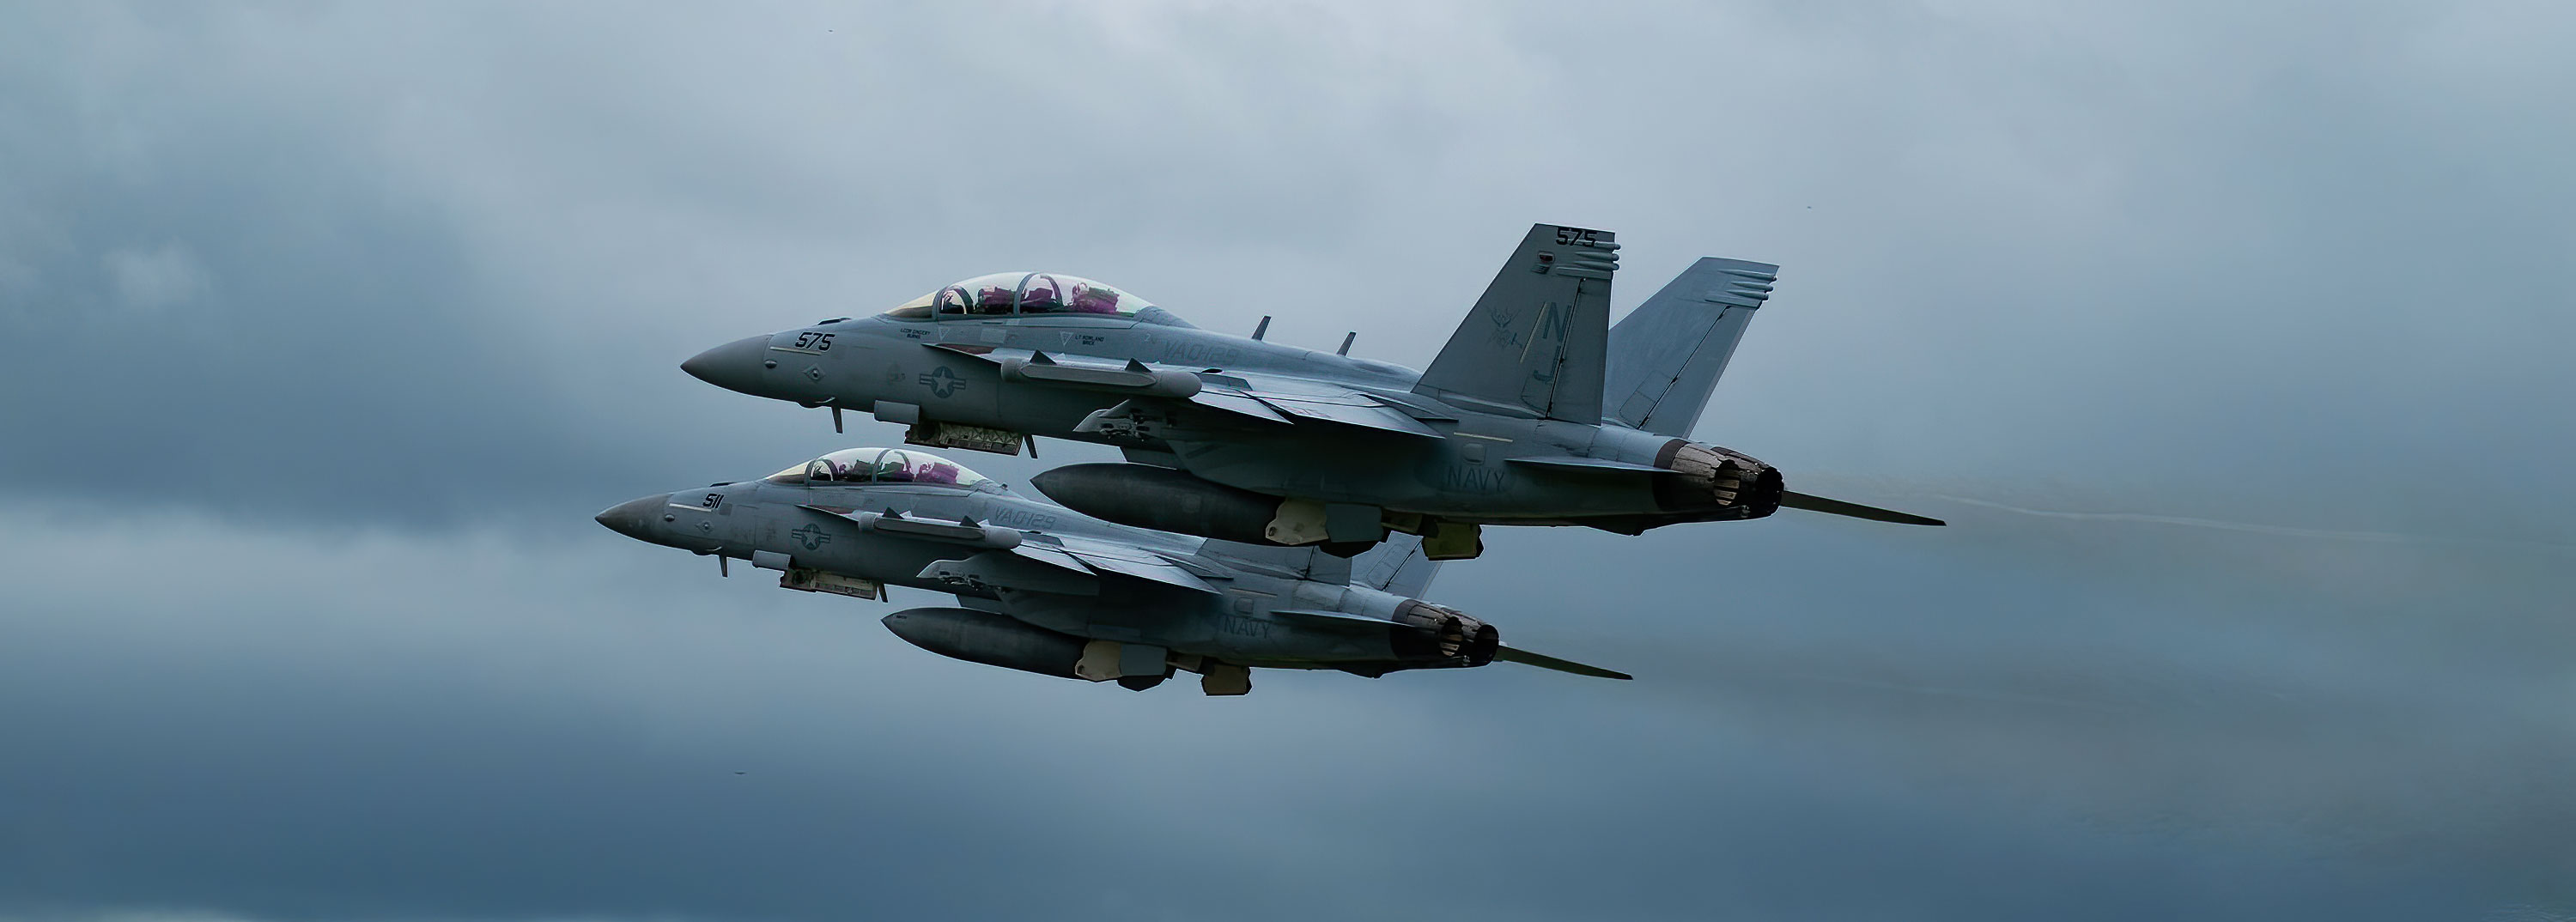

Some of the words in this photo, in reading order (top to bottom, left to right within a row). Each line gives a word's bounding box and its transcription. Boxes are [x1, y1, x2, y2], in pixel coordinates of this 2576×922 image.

[1556, 227, 1597, 247] 575
[1542, 302, 1572, 342] N
[794, 331, 835, 351] 575
[1447, 465, 1505, 492] NAVY
[702, 493, 725, 509] 511
[1224, 616, 1272, 639] NAVY
